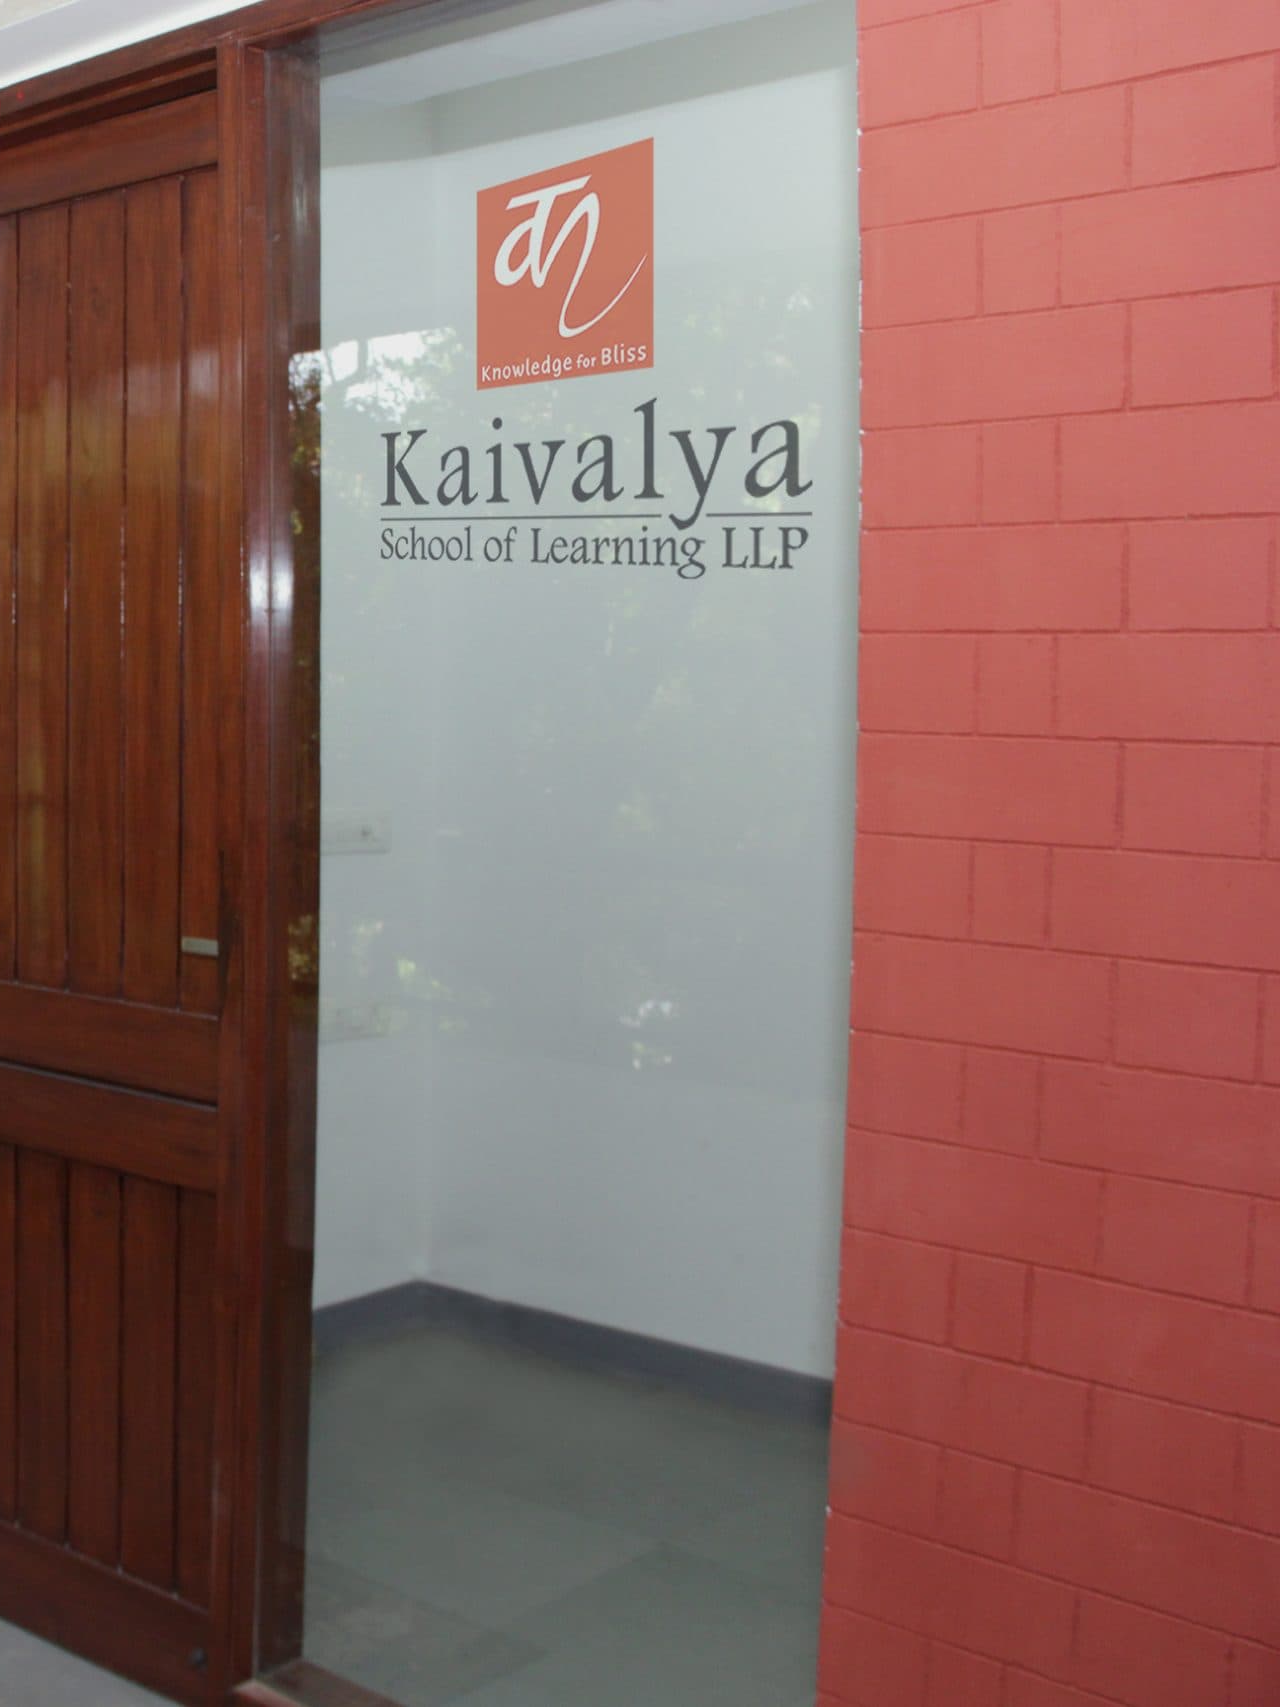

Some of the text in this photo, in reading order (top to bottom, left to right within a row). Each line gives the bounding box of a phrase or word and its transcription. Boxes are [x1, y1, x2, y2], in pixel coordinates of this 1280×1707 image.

[481, 343, 647, 382] Knowledge for Bliss
[380, 398, 813, 530] Kaivalya
[380, 526, 809, 580] School of Learning LLP
